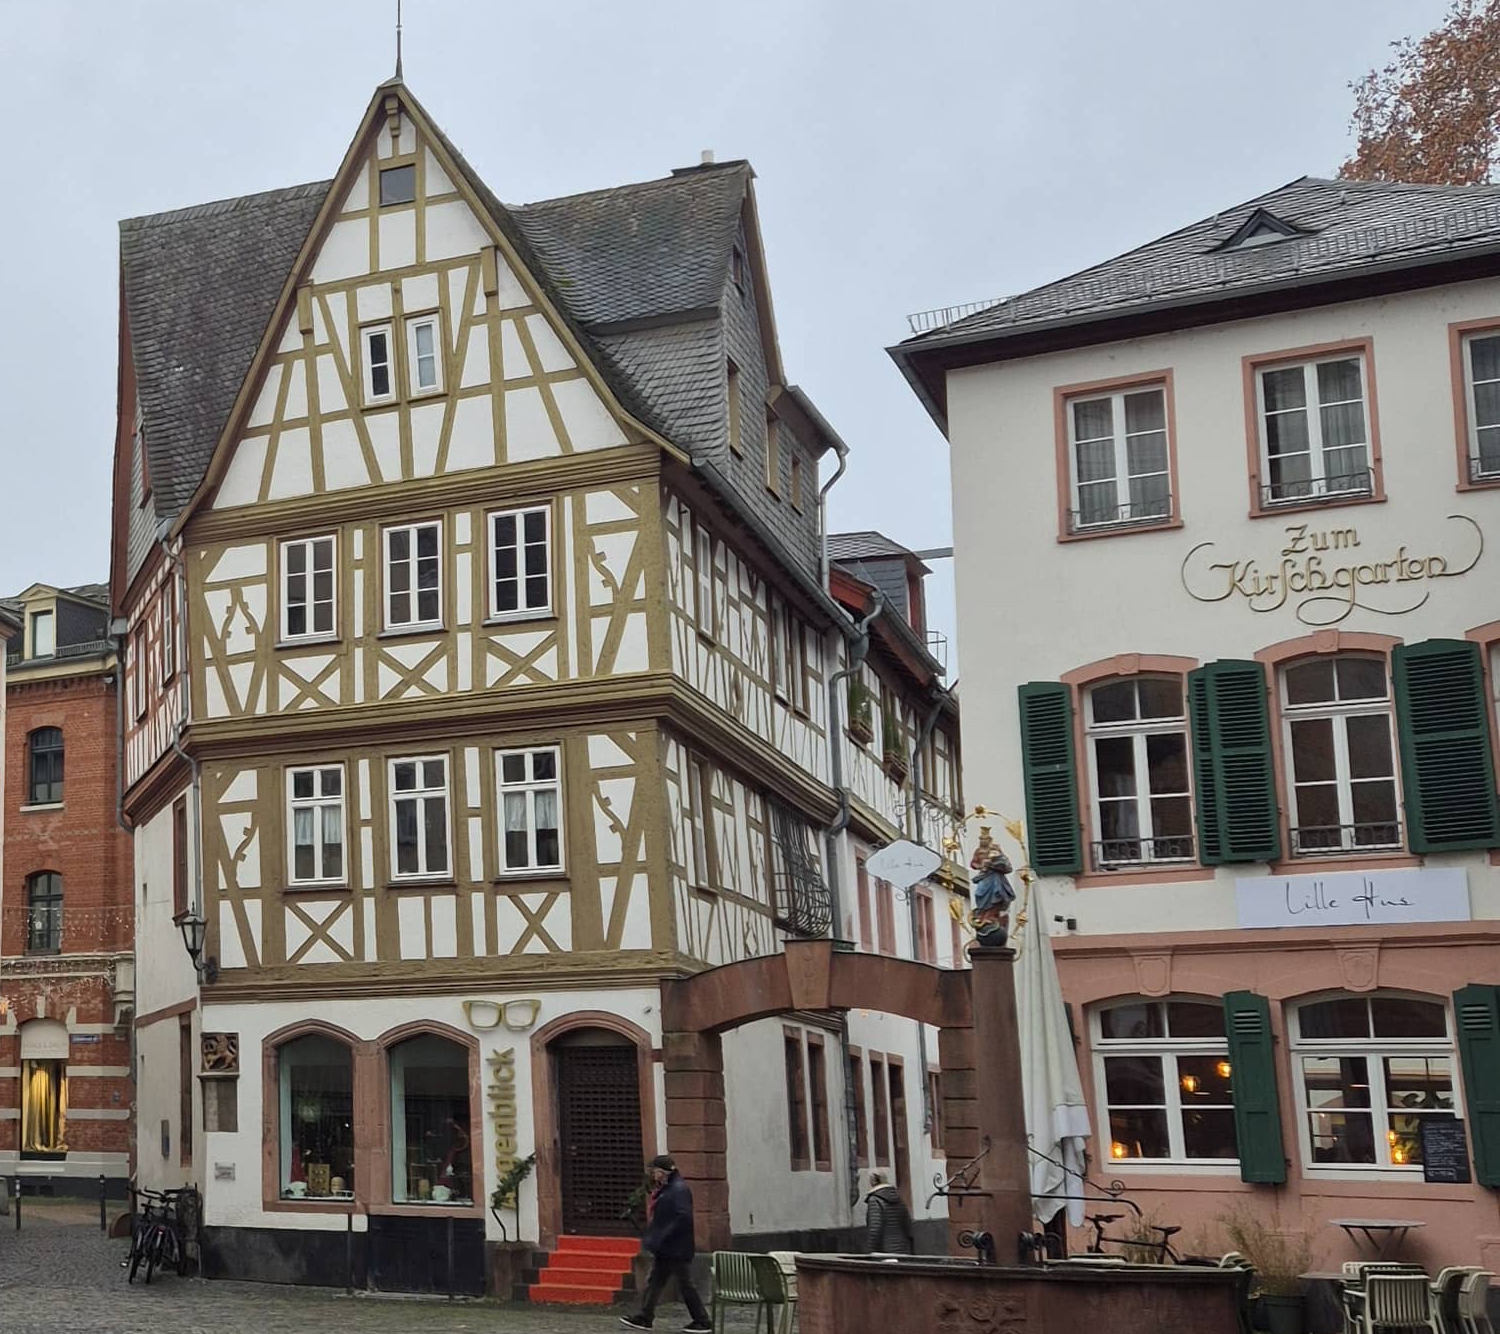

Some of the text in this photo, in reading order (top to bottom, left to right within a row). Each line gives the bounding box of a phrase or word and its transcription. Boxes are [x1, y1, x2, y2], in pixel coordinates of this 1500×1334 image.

[1281, 524, 1361, 556] Zum
[1285, 876, 1415, 919] Lille Hus
[485, 1047, 517, 1211] Agenblick
